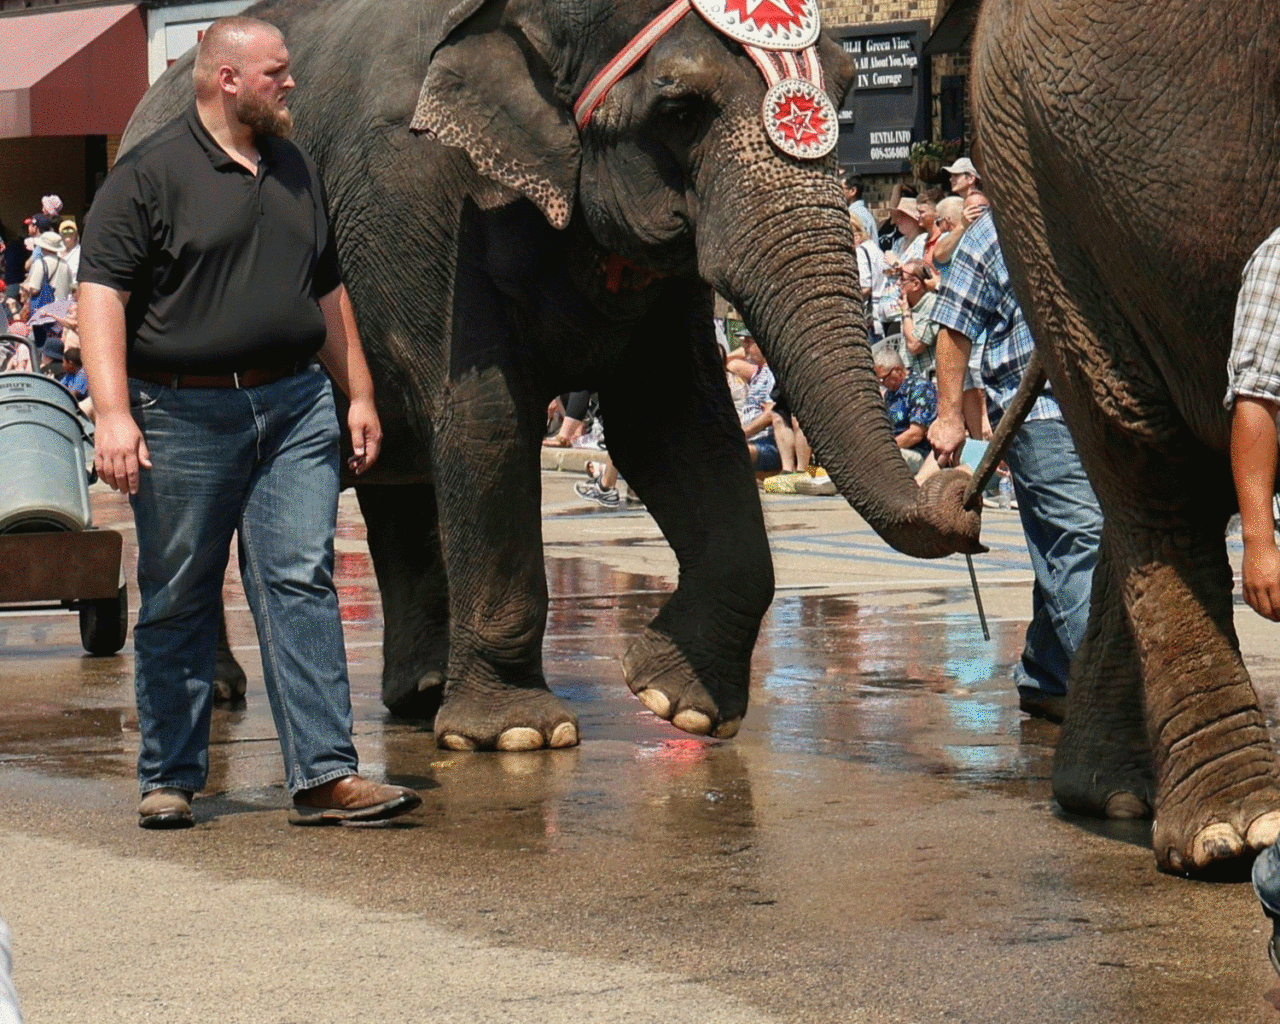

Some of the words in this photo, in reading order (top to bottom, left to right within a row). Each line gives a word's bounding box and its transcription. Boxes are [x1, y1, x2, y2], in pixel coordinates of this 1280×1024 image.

[866, 39, 891, 53] Green
[892, 36, 911, 50] Vine
[870, 55, 888, 69] About
[857, 74, 869, 88] IN
[872, 71, 903, 87] Courage
[870, 131, 895, 145] RENTAL
[895, 130, 911, 144] INFO
